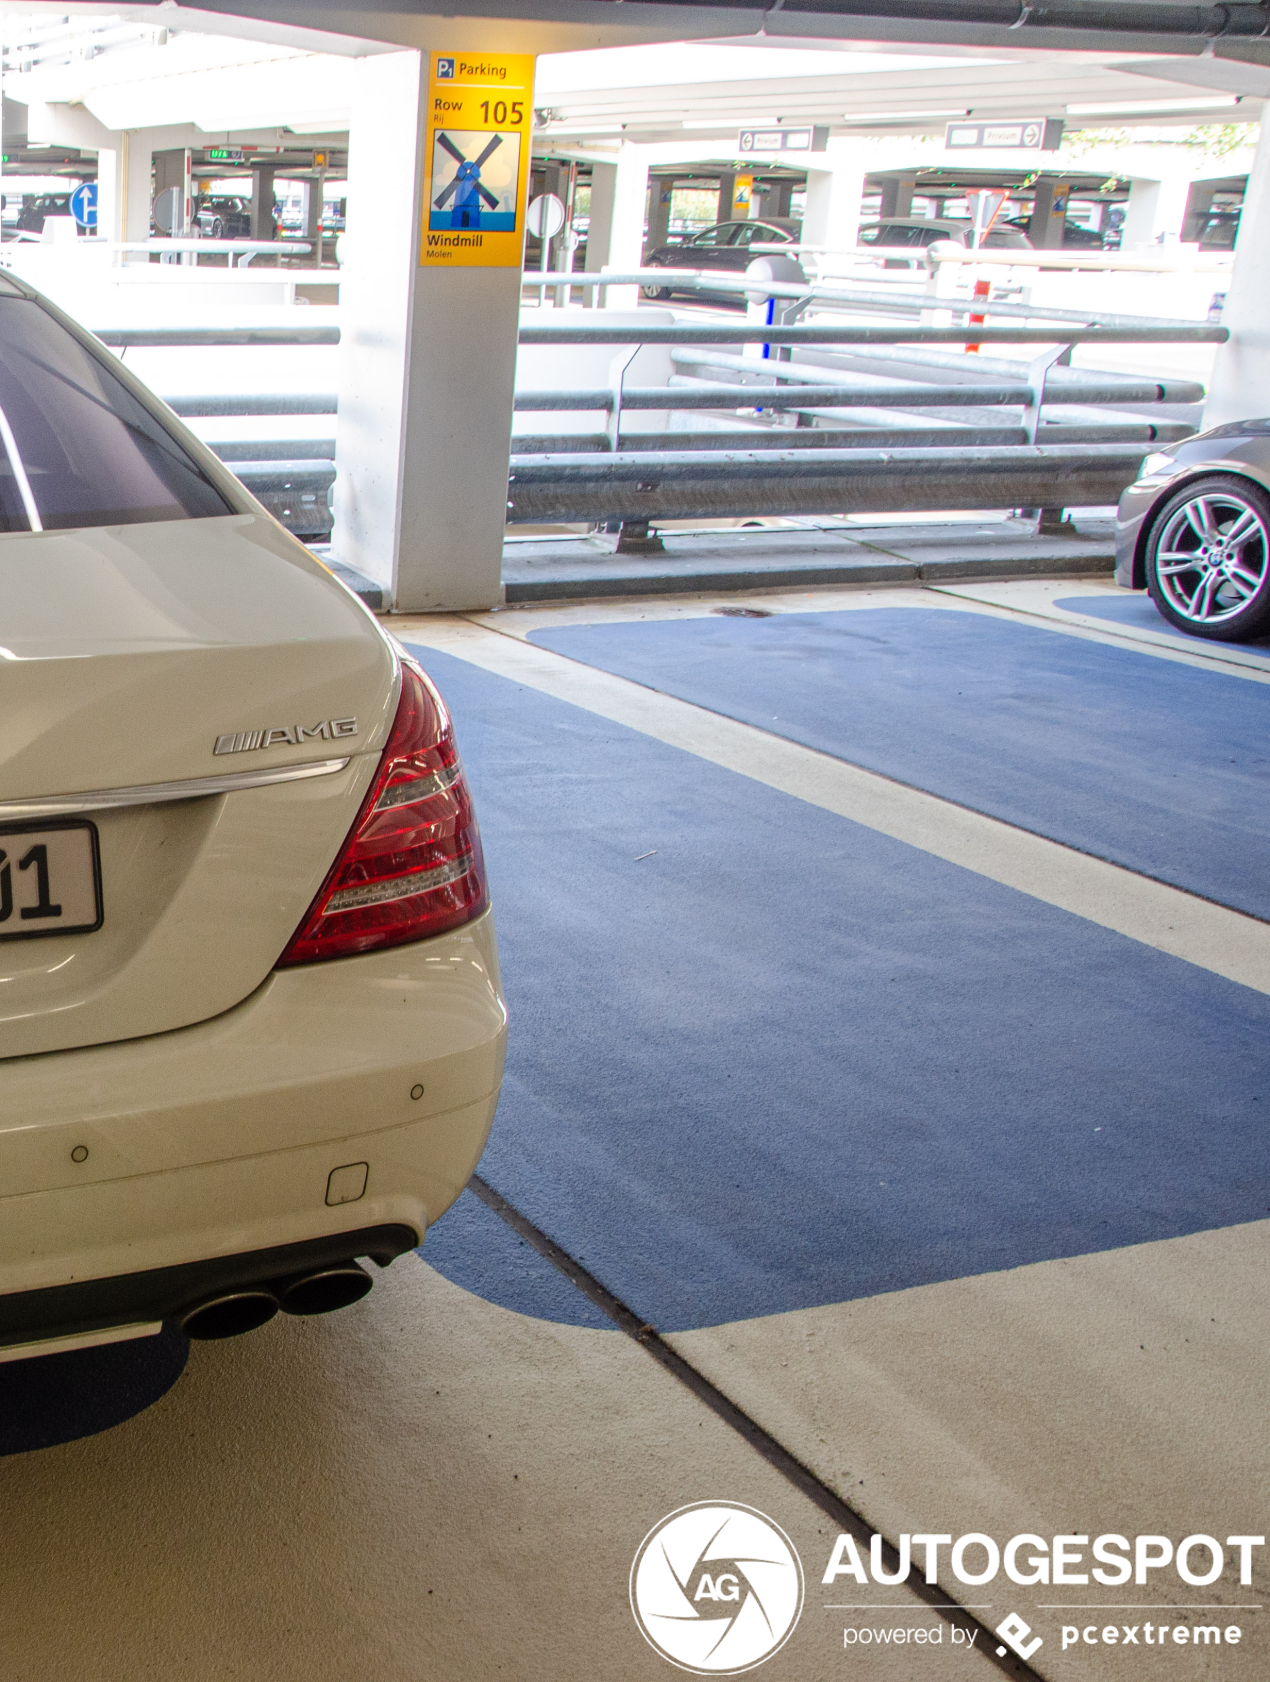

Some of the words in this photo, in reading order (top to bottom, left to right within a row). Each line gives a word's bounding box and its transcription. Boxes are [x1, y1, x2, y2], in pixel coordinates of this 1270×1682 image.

[459, 63, 507, 79] Parking
[434, 98, 463, 111] Row
[480, 101, 524, 125] 105
[433, 114, 444, 124] Rij
[426, 234, 483, 247] Windmill
[426, 250, 453, 259] Molen
[262, 717, 358, 748] AMG
